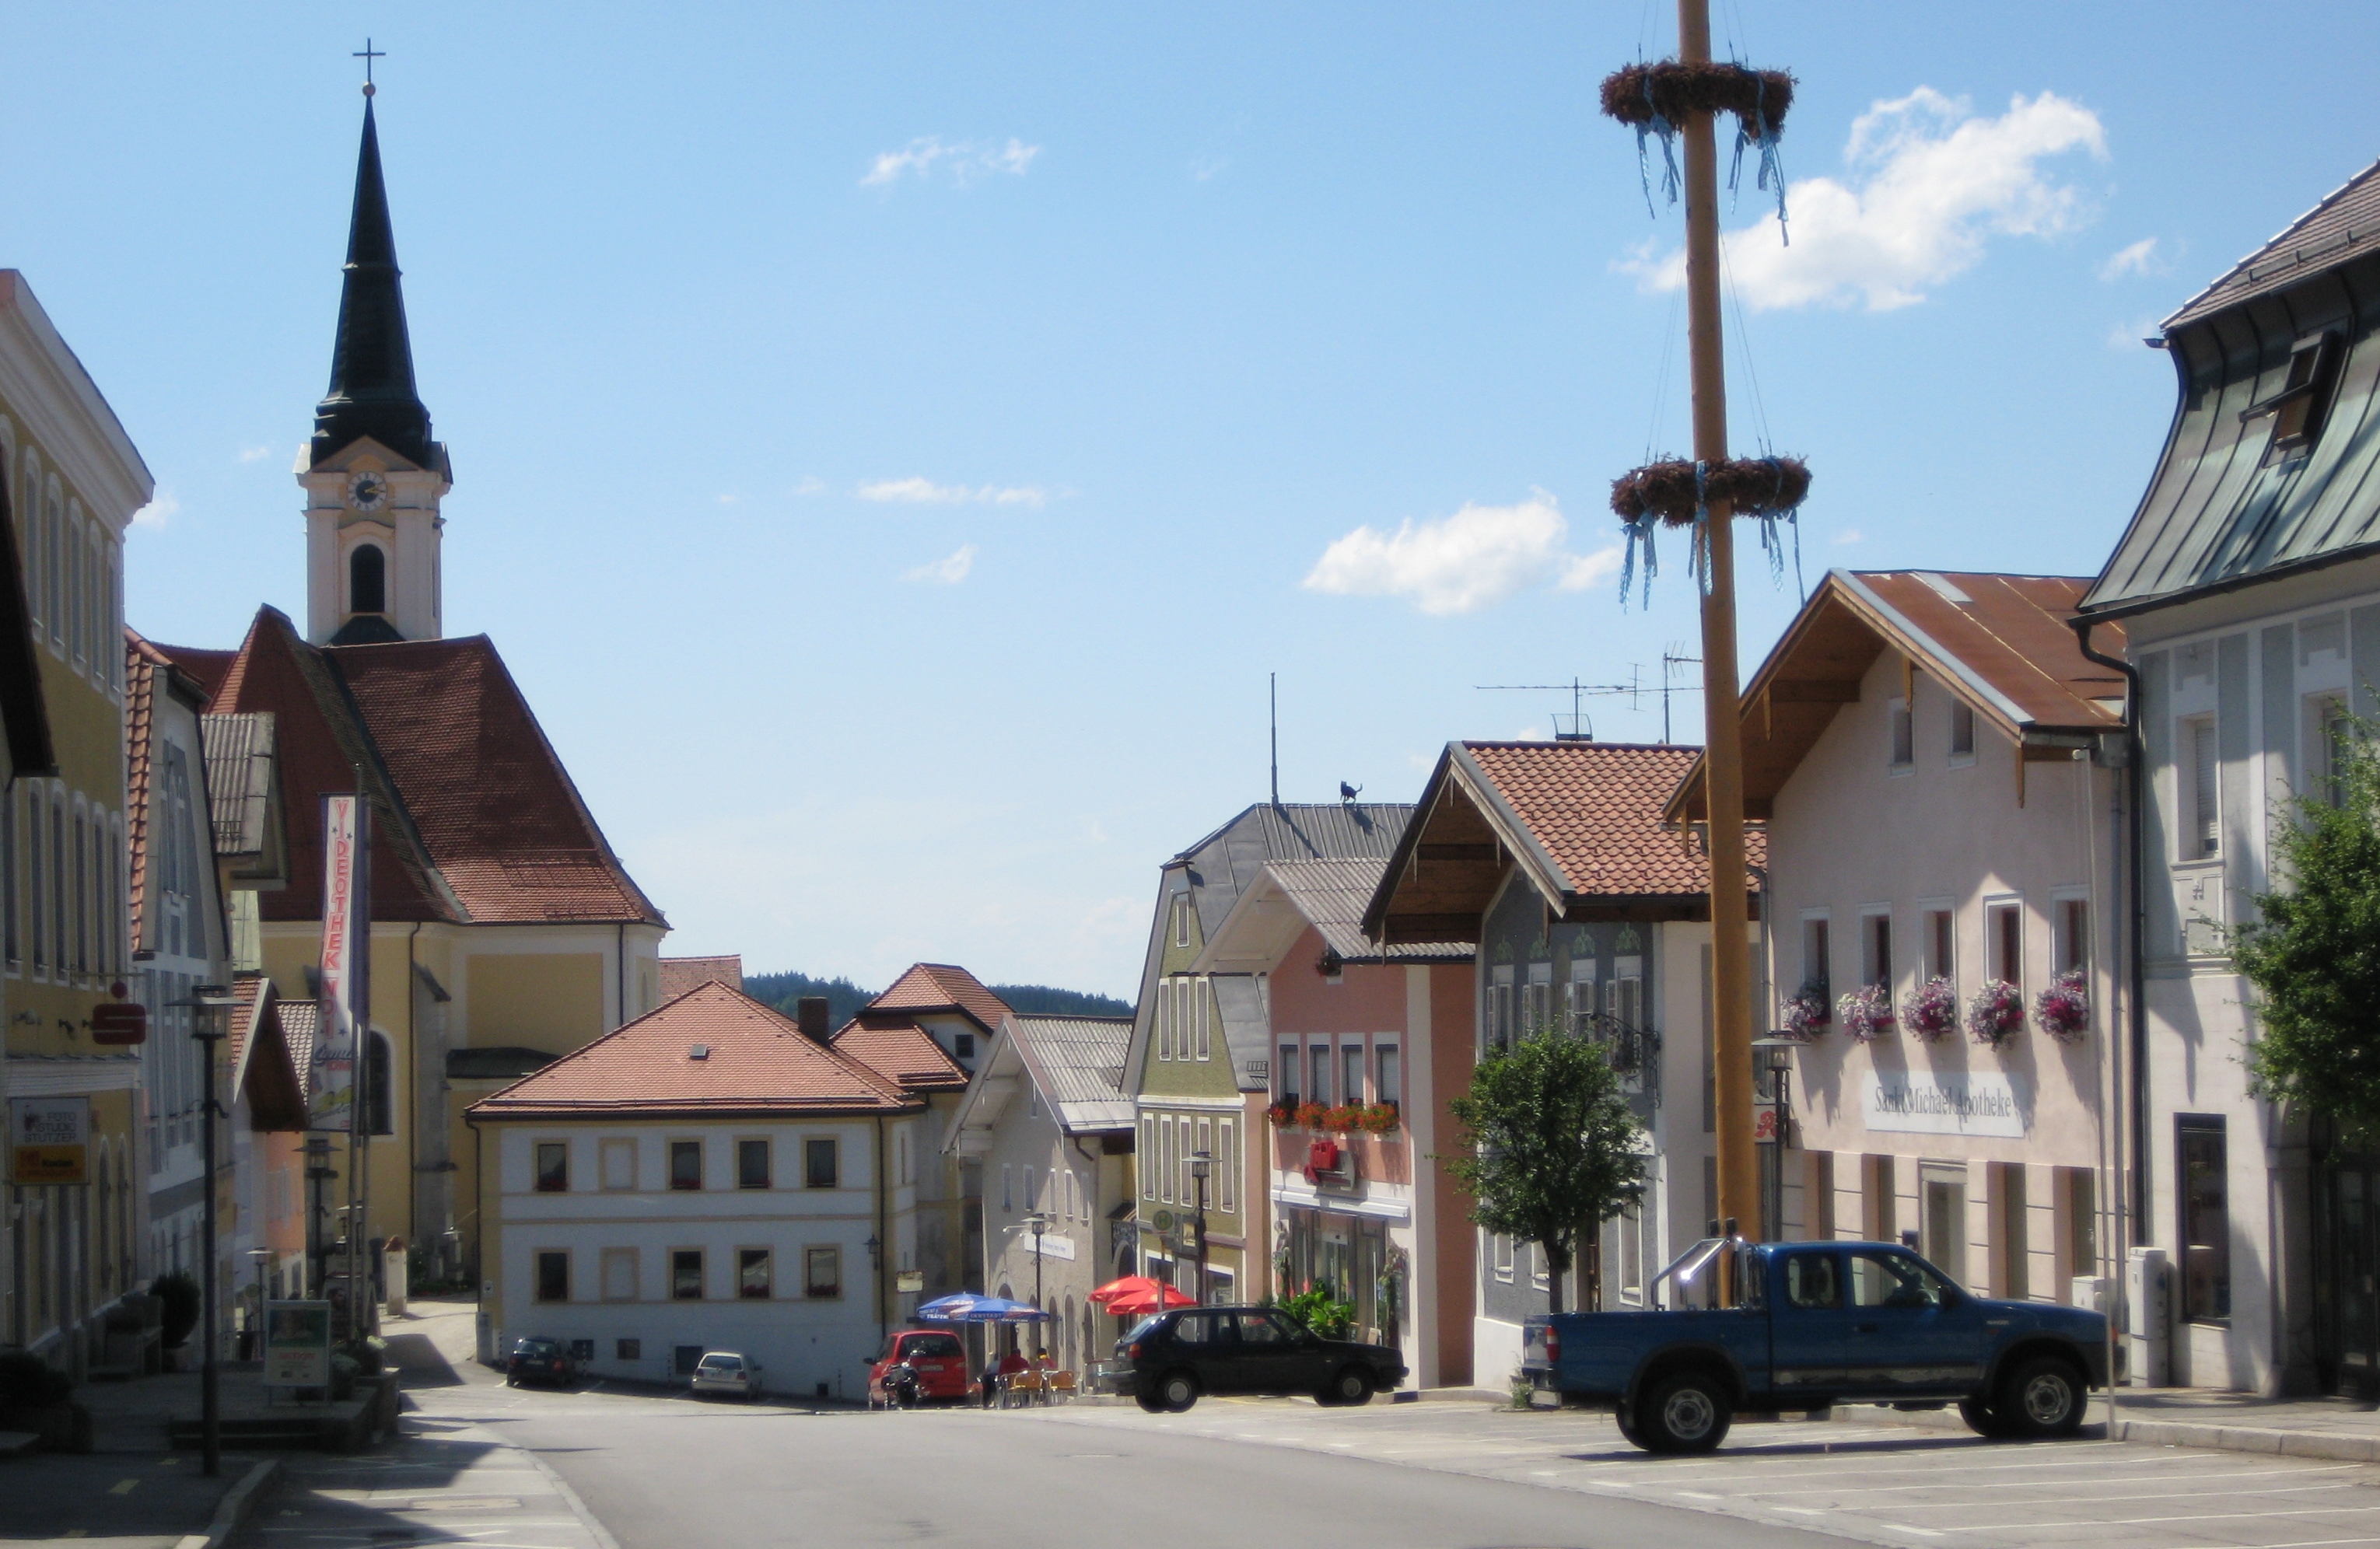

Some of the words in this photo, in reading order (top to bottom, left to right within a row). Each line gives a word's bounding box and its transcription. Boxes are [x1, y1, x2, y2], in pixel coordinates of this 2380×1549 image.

[324, 799, 349, 970] VIDEOTHEK
[1875, 1086, 1906, 1114] Sankt
[1907, 1087, 1952, 1116] Michael
[1955, 1089, 2011, 1123] Apotheke
[38, 1122, 76, 1132] STUDIO
[47, 1112, 76, 1121] FOTO
